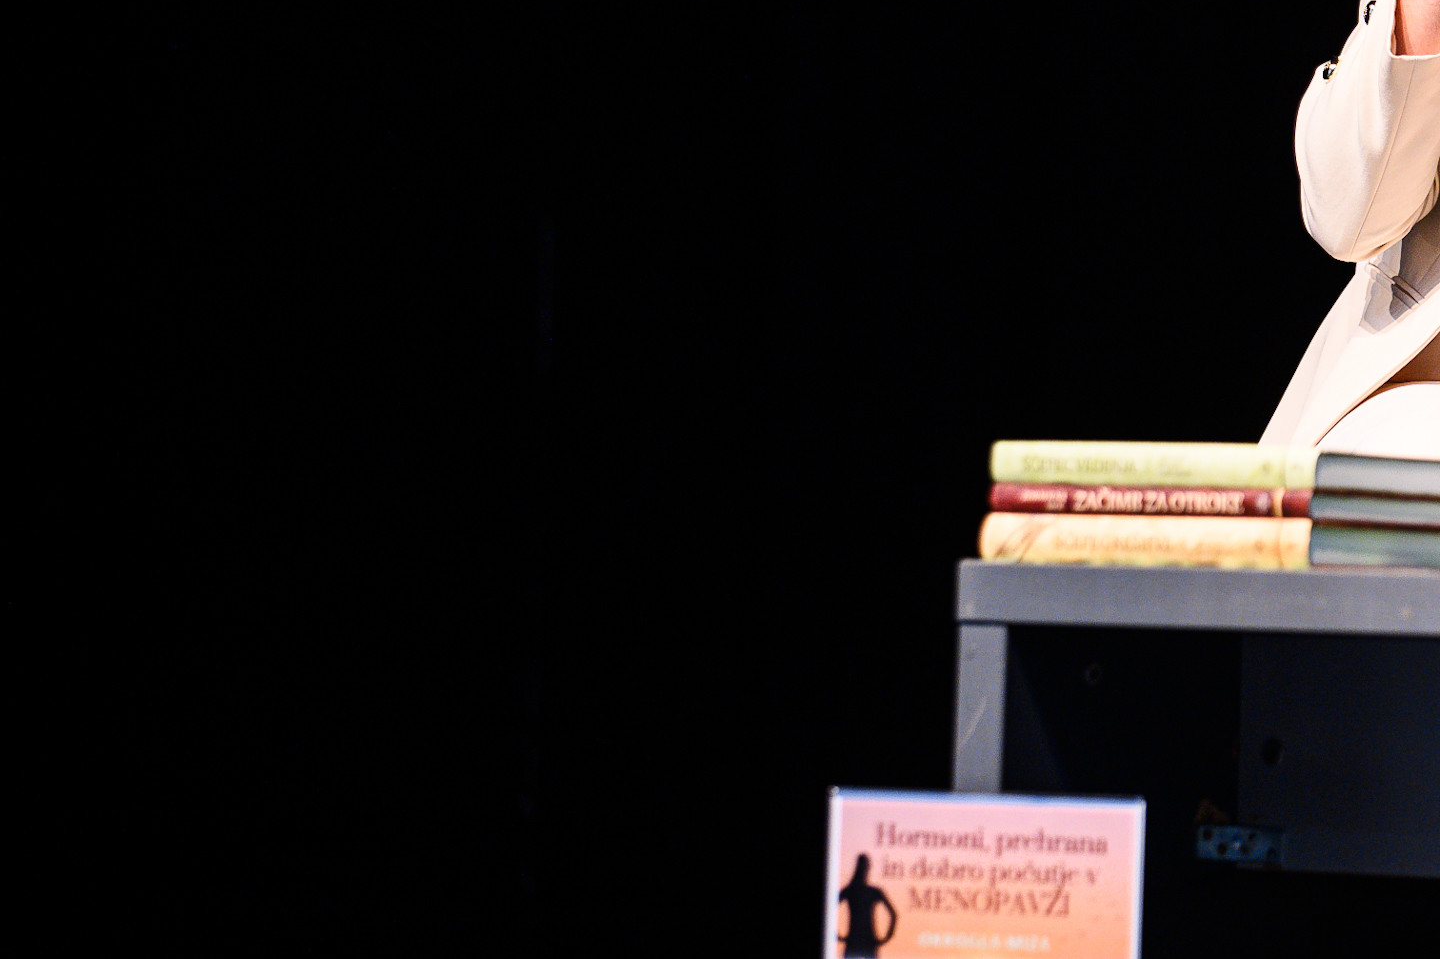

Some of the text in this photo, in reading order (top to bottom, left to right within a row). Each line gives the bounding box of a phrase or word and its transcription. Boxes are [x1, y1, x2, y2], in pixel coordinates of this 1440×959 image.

[1143, 491, 1168, 514] ZA
[1169, 491, 1245, 515] OTROKE
[876, 822, 1108, 858] Hormoni, prehrana
[882, 855, 1098, 891] in dobro počutje v
